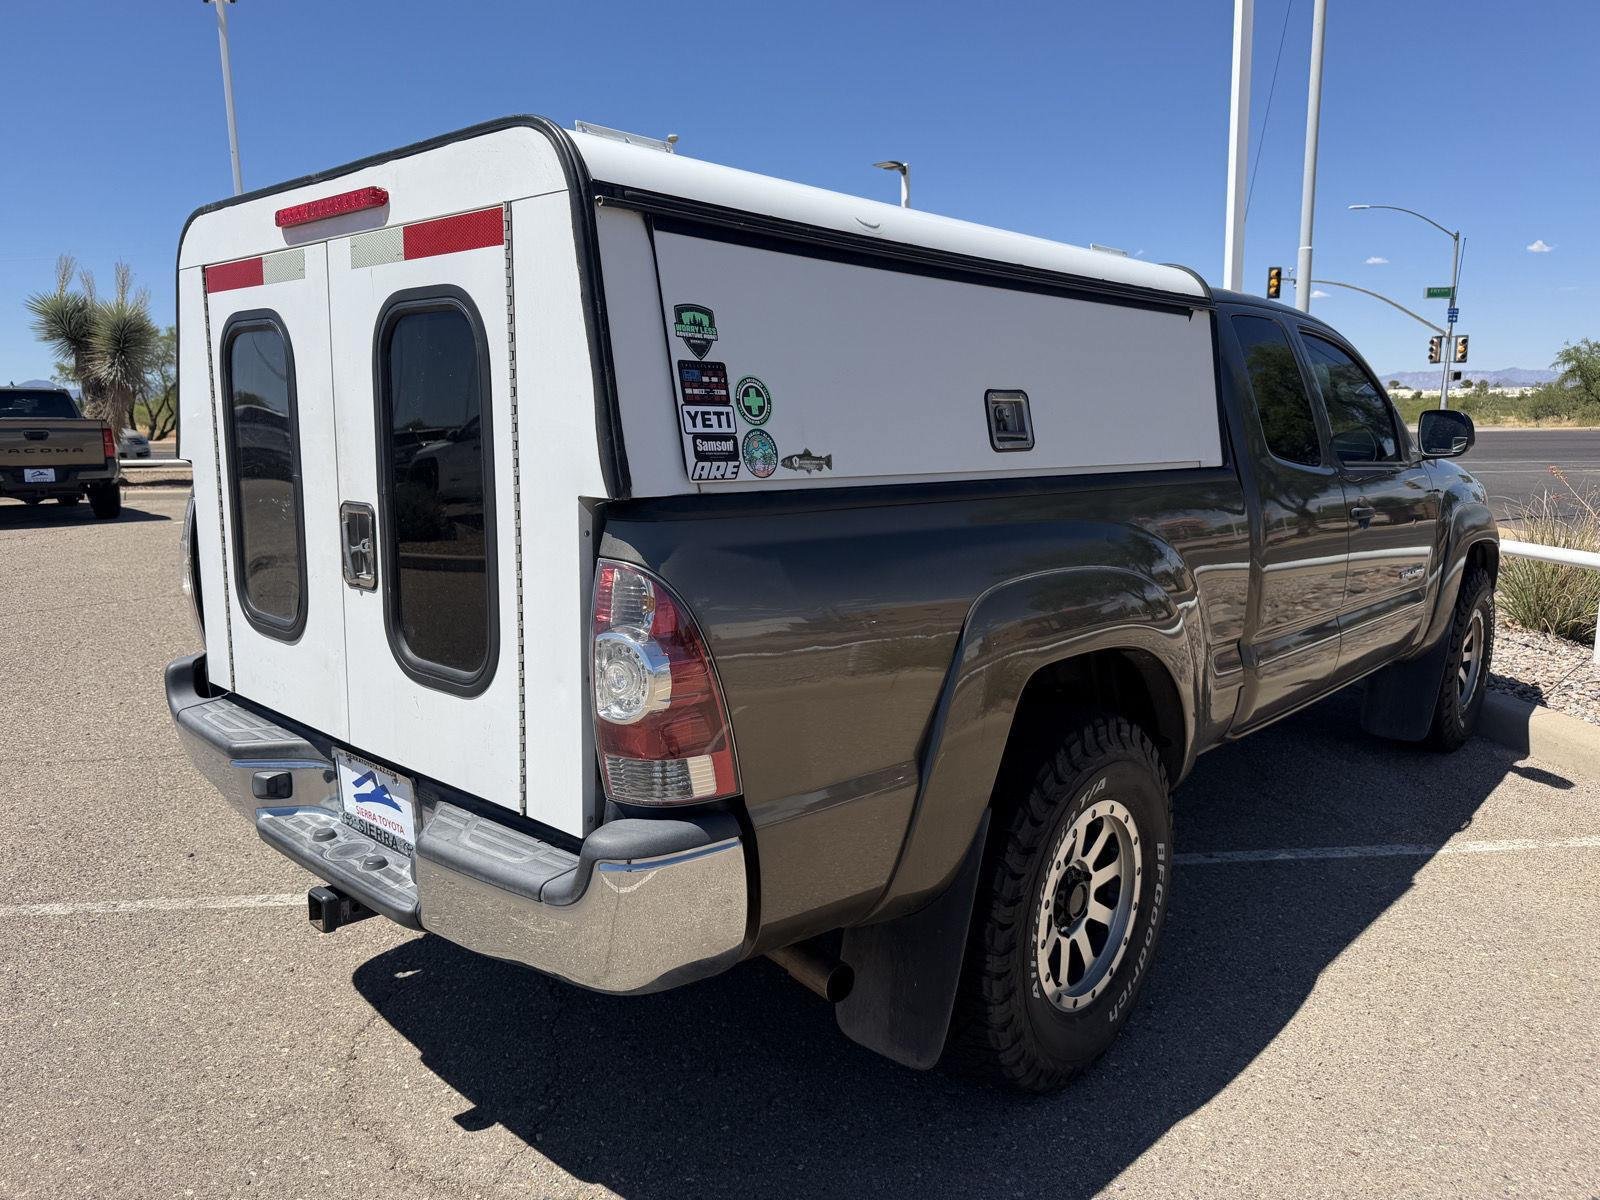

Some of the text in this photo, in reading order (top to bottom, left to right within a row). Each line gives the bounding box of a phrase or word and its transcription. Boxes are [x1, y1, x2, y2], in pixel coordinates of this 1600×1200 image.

[675, 323, 717, 336] WORRY LESS
[685, 410, 732, 429] YETI
[696, 438, 734, 452] Samson
[691, 461, 741, 480] ARE
[1079, 776, 1107, 809] T/A
[355, 805, 406, 836] SIERRA TOYOTA
[358, 818, 399, 851] SIERRA
[1108, 842, 1166, 1023] BFGoodrich
